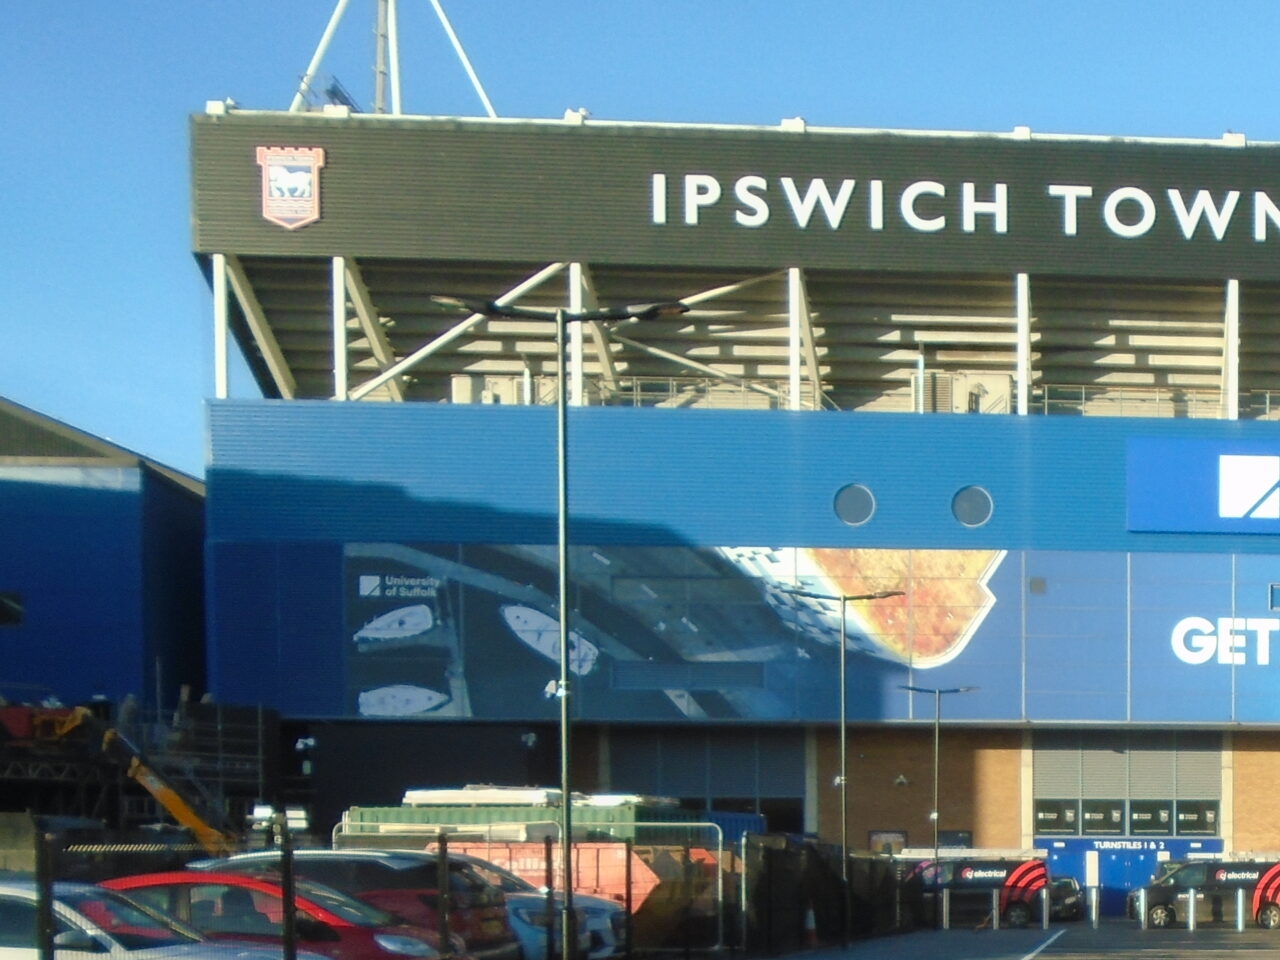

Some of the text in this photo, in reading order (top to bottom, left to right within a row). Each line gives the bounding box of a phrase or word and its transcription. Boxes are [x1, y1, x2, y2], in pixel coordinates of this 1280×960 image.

[652, 173, 1008, 234] IPSWICH
[385, 575, 440, 588] University
[385, 587, 437, 597] of Suffolk
[1171, 616, 1280, 665] GET
[1093, 841, 1142, 849] TURNSTILES
[1160, 841, 1165, 849] 2
[974, 869, 1007, 878] electrical
[1227, 871, 1260, 879] electrical
